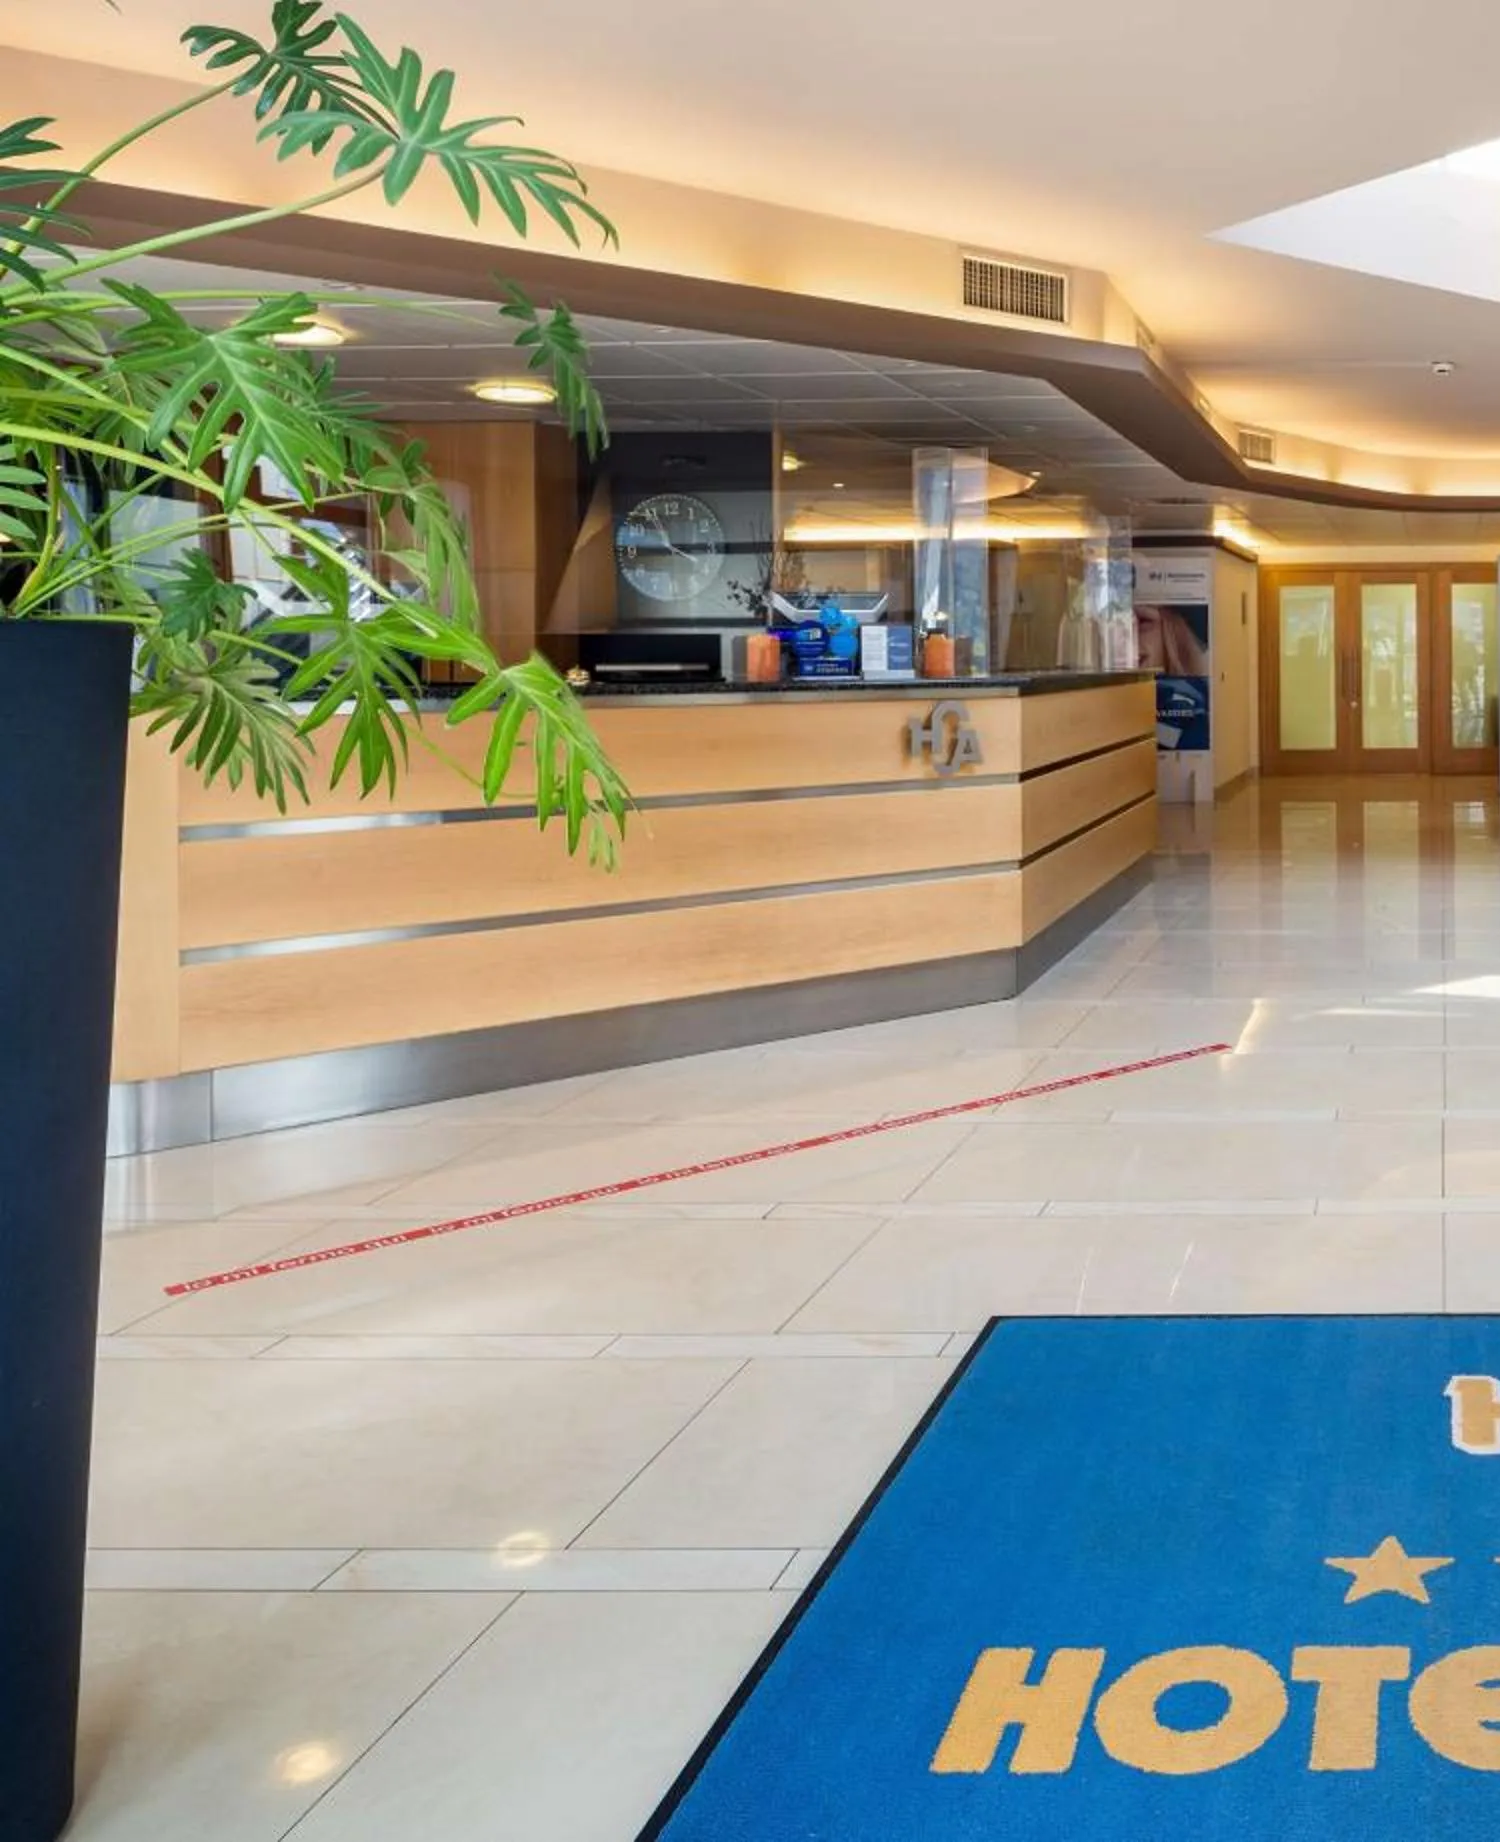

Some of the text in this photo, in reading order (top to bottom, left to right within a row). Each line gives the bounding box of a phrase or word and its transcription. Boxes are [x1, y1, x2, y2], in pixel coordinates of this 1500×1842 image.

[664, 501, 679, 515] 12
[502, 1194, 578, 1218] fermo
[269, 1245, 355, 1271] fermo
[363, 1233, 407, 1250] qui
